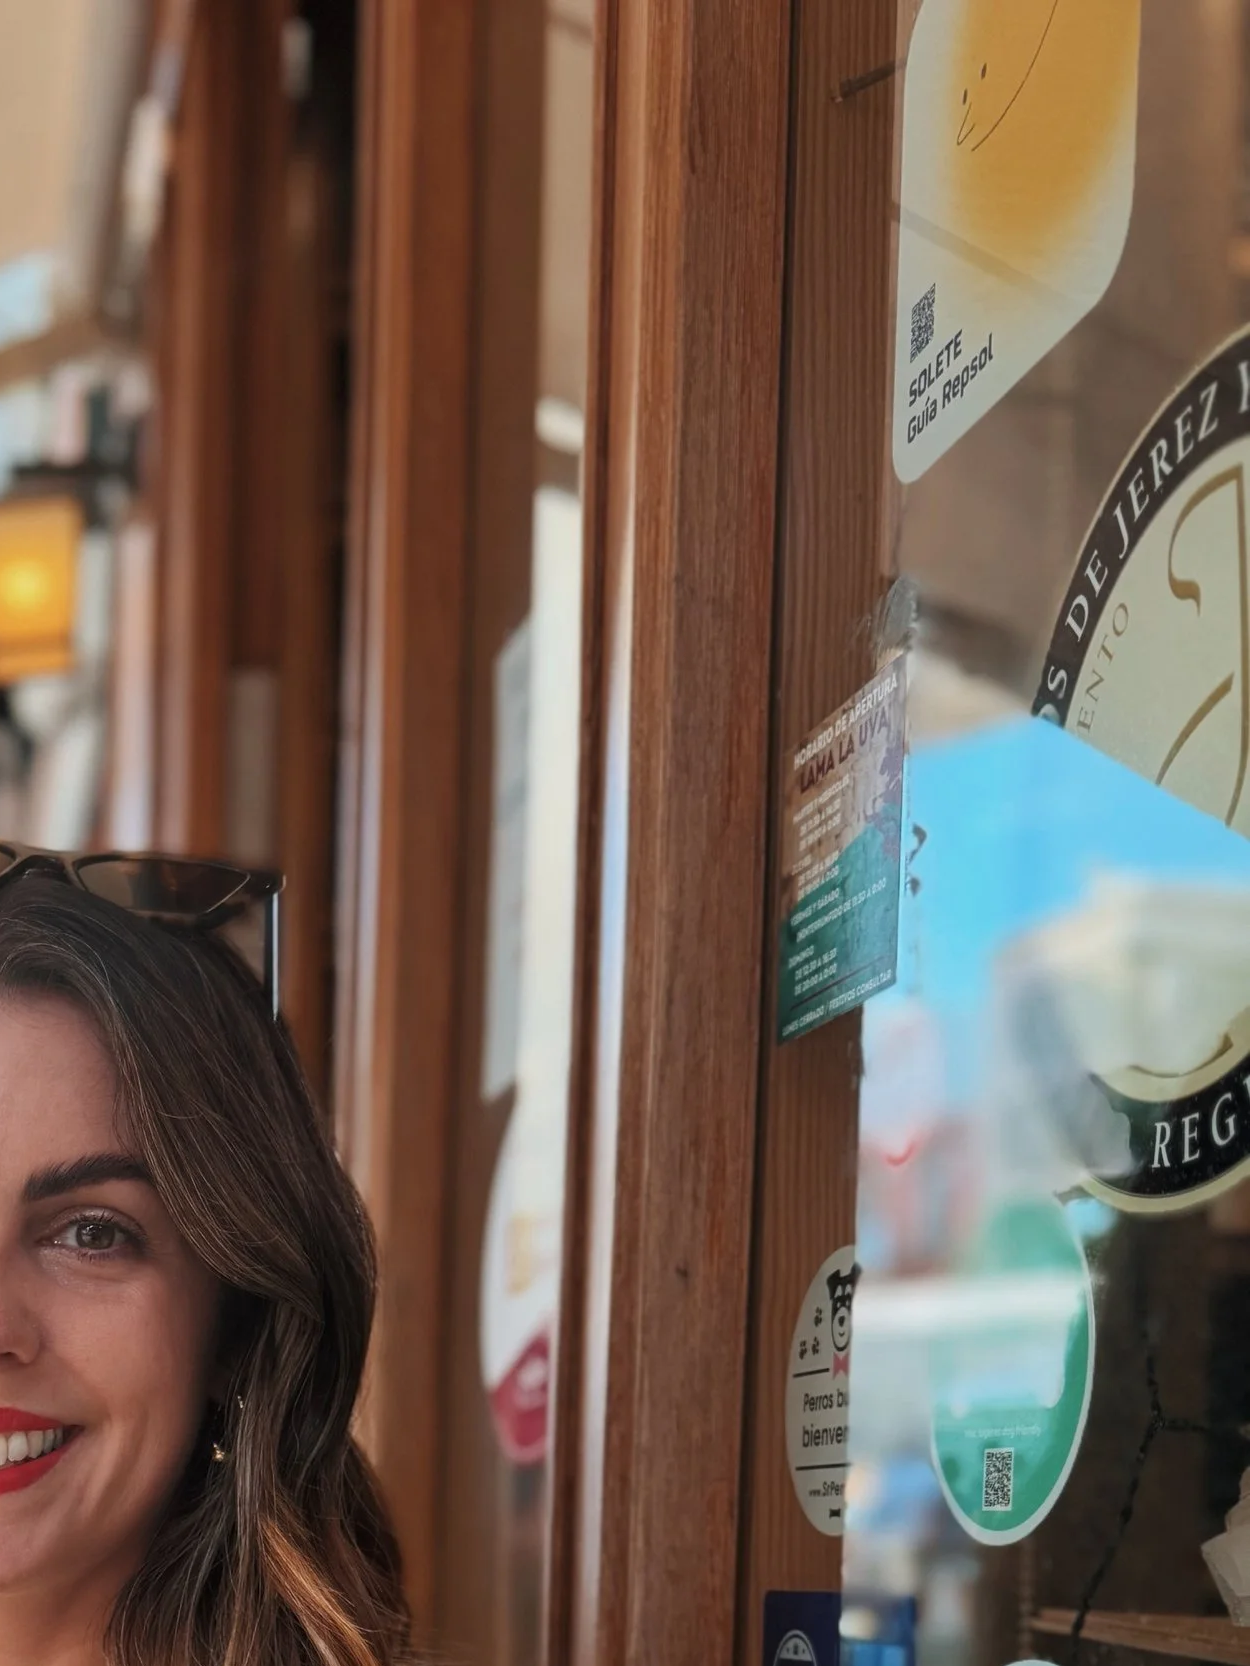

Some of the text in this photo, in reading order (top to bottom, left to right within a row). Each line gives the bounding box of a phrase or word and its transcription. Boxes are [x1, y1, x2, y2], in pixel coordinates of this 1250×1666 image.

[907, 332, 993, 444] Guía Repsol
[908, 328, 963, 408] SOLETE
[1064, 549, 1109, 642] DE
[1112, 380, 1220, 560] JEREZ
[793, 673, 898, 771] HORARIO DE APERTURA
[800, 705, 889, 795] LAMA LA UVA
[1151, 1073, 1250, 1168] REG
[803, 1392, 834, 1412] Perros
